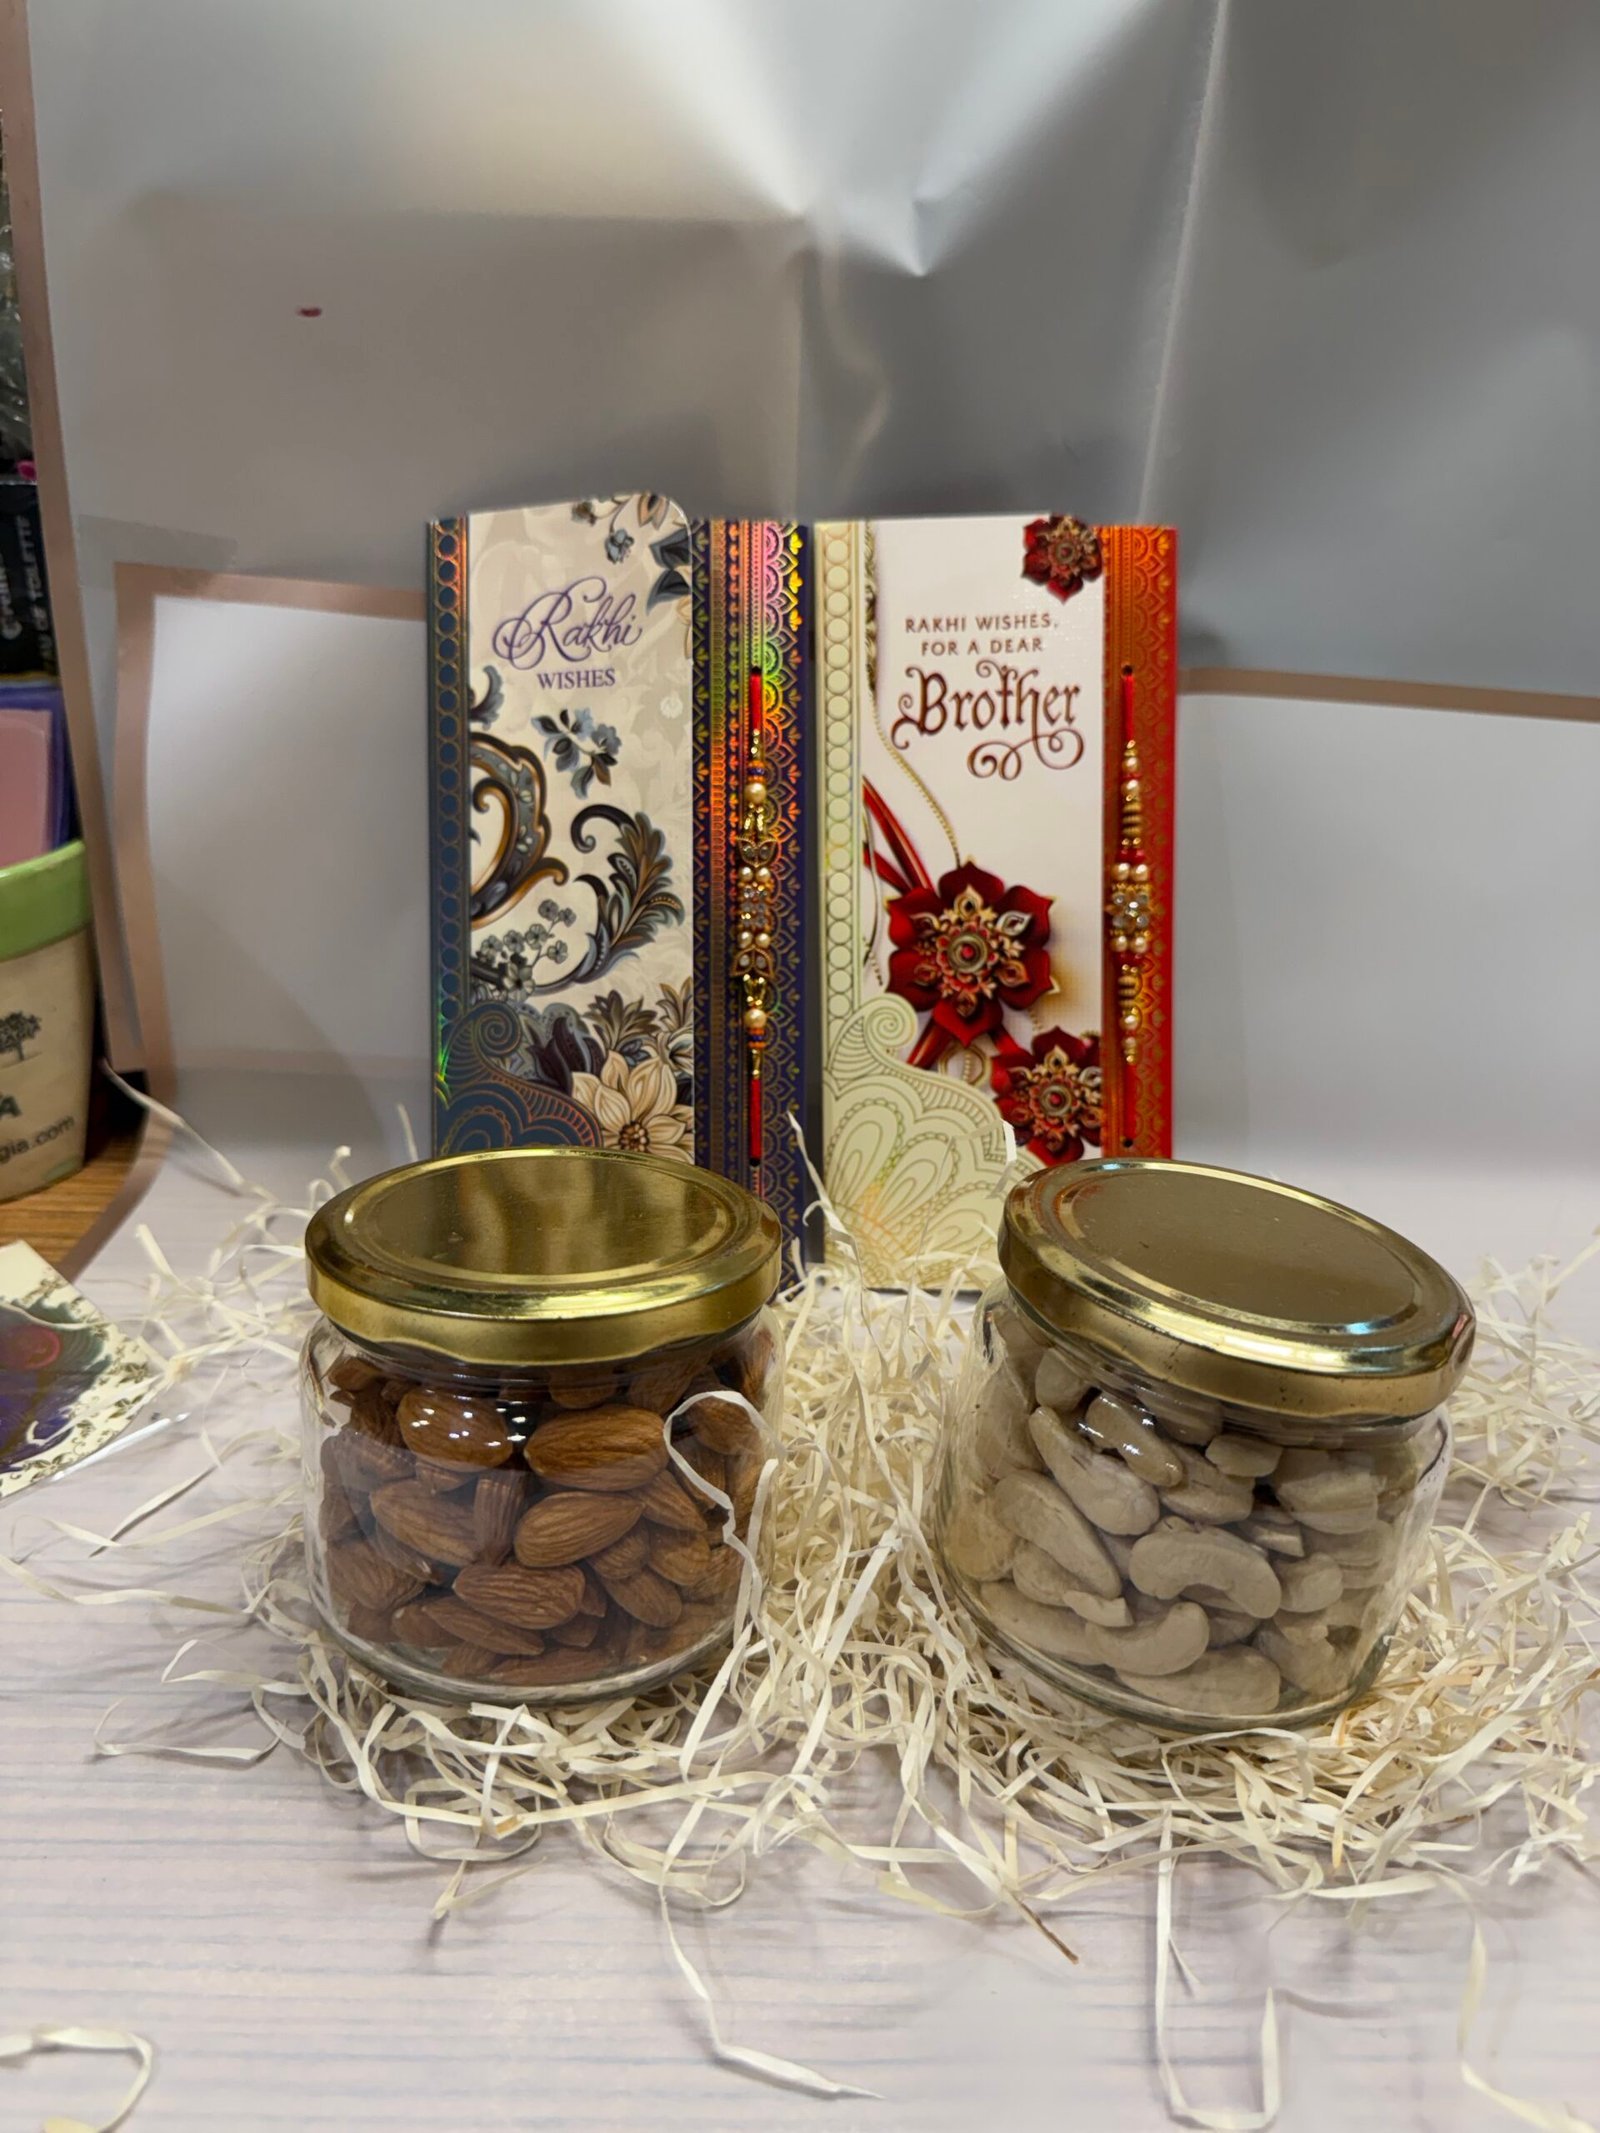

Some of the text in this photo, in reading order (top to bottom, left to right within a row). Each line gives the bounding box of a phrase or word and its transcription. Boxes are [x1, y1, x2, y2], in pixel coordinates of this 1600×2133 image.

[492, 575, 643, 670] Rakhi
[905, 616, 966, 633] RAKHI
[921, 637, 1043, 656] FOR A DEAR
[536, 668, 616, 690] WISHES
[891, 659, 1084, 781] Brother
